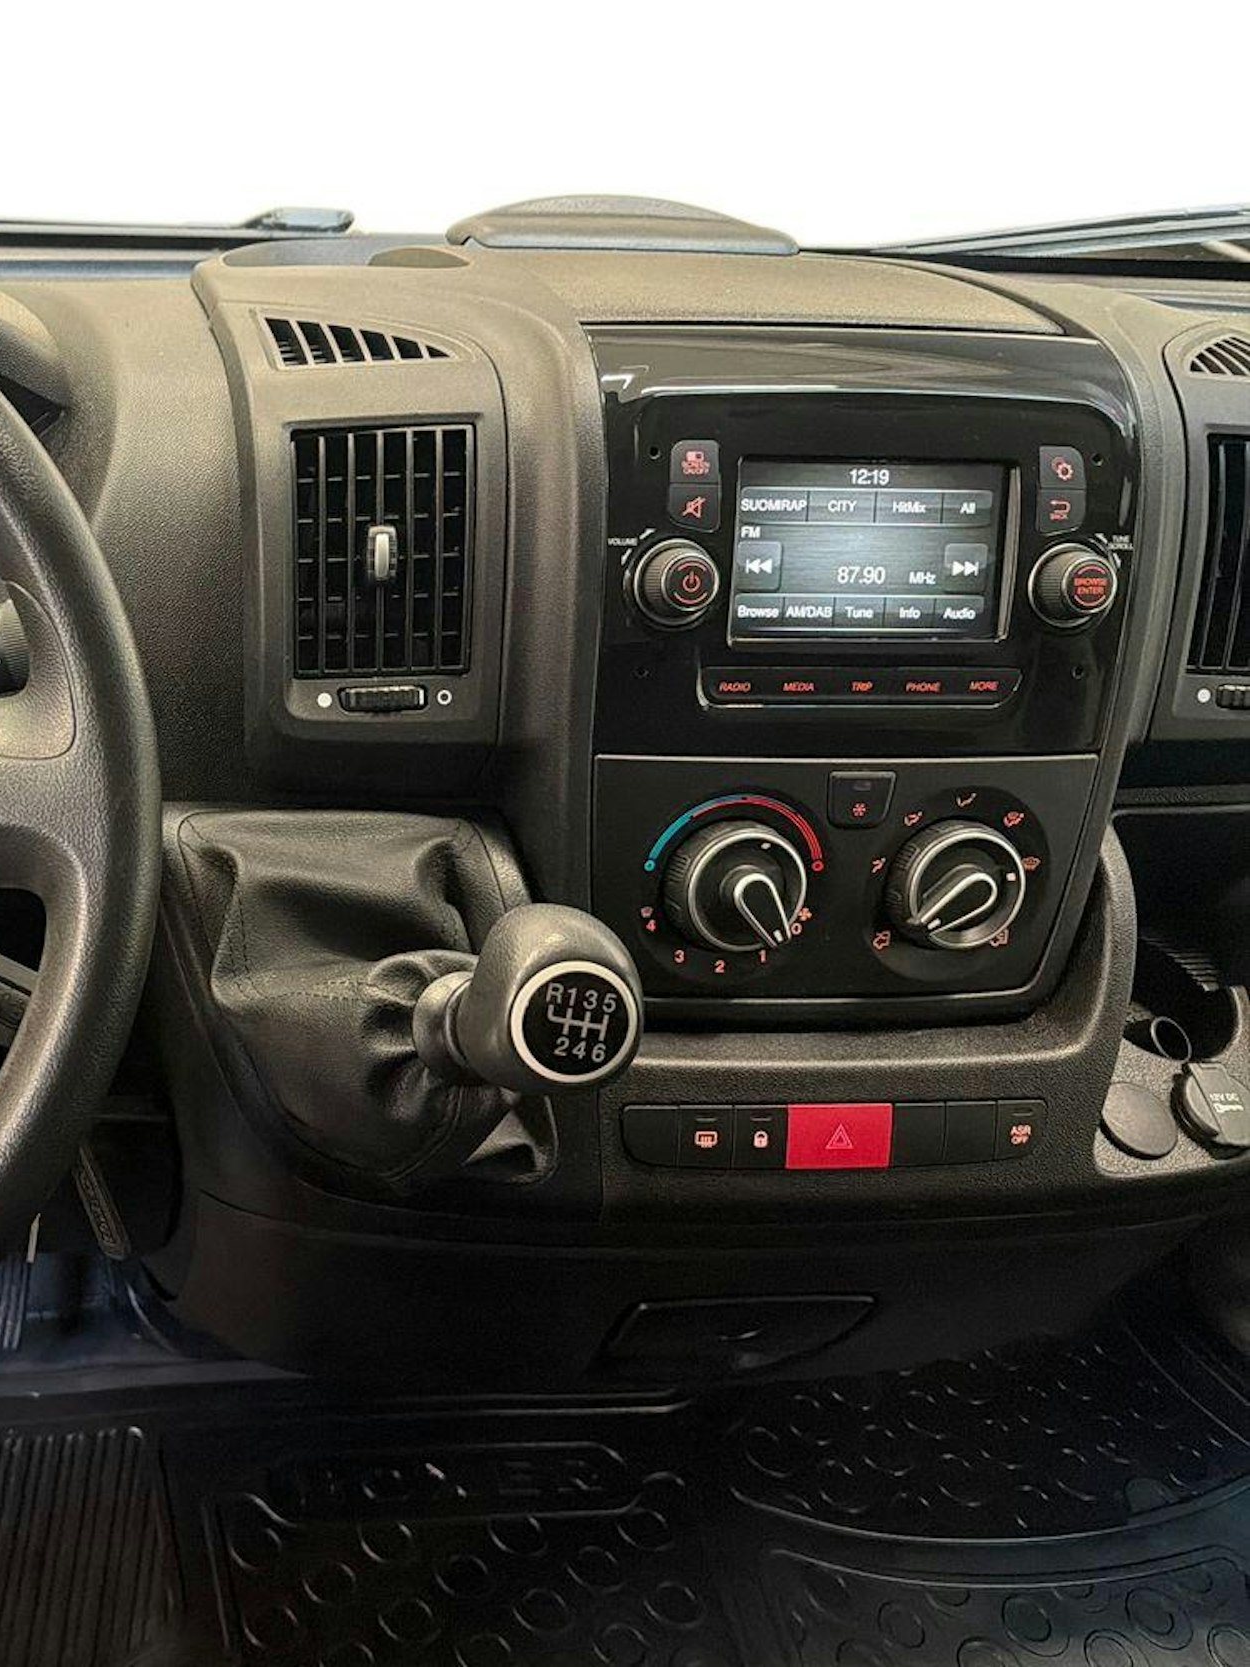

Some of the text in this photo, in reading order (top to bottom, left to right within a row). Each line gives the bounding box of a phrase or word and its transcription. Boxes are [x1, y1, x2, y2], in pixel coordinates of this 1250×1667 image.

[849, 469, 890, 485] 12:19
[740, 498, 808, 512] SUOMIRAP
[827, 500, 857, 513] CITY
[892, 501, 926, 514] HitMix
[960, 501, 976, 514] All
[740, 526, 761, 538] FM
[608, 537, 638, 546] VOLUME
[836, 566, 936, 585] 87.90 MHz
[1075, 586, 1105, 595] ENTER
[737, 605, 779, 618] Browse
[785, 605, 832, 618] AM/DAB
[845, 606, 873, 619] Tune
[899, 606, 921, 619] Info
[943, 606, 976, 619] Audio
[719, 682, 751, 692] RADIO
[783, 682, 815, 692] MEDIA
[851, 682, 874, 692] TRIP
[906, 682, 941, 692] PHONE
[969, 681, 1000, 692] MORE
[646, 919, 657, 932] 4
[674, 950, 685, 963] 3
[758, 950, 766, 963] 1
[714, 960, 726, 973] 2
[546, 982, 617, 1013] R 1 3 5
[553, 1036, 607, 1062] 2 4 6
